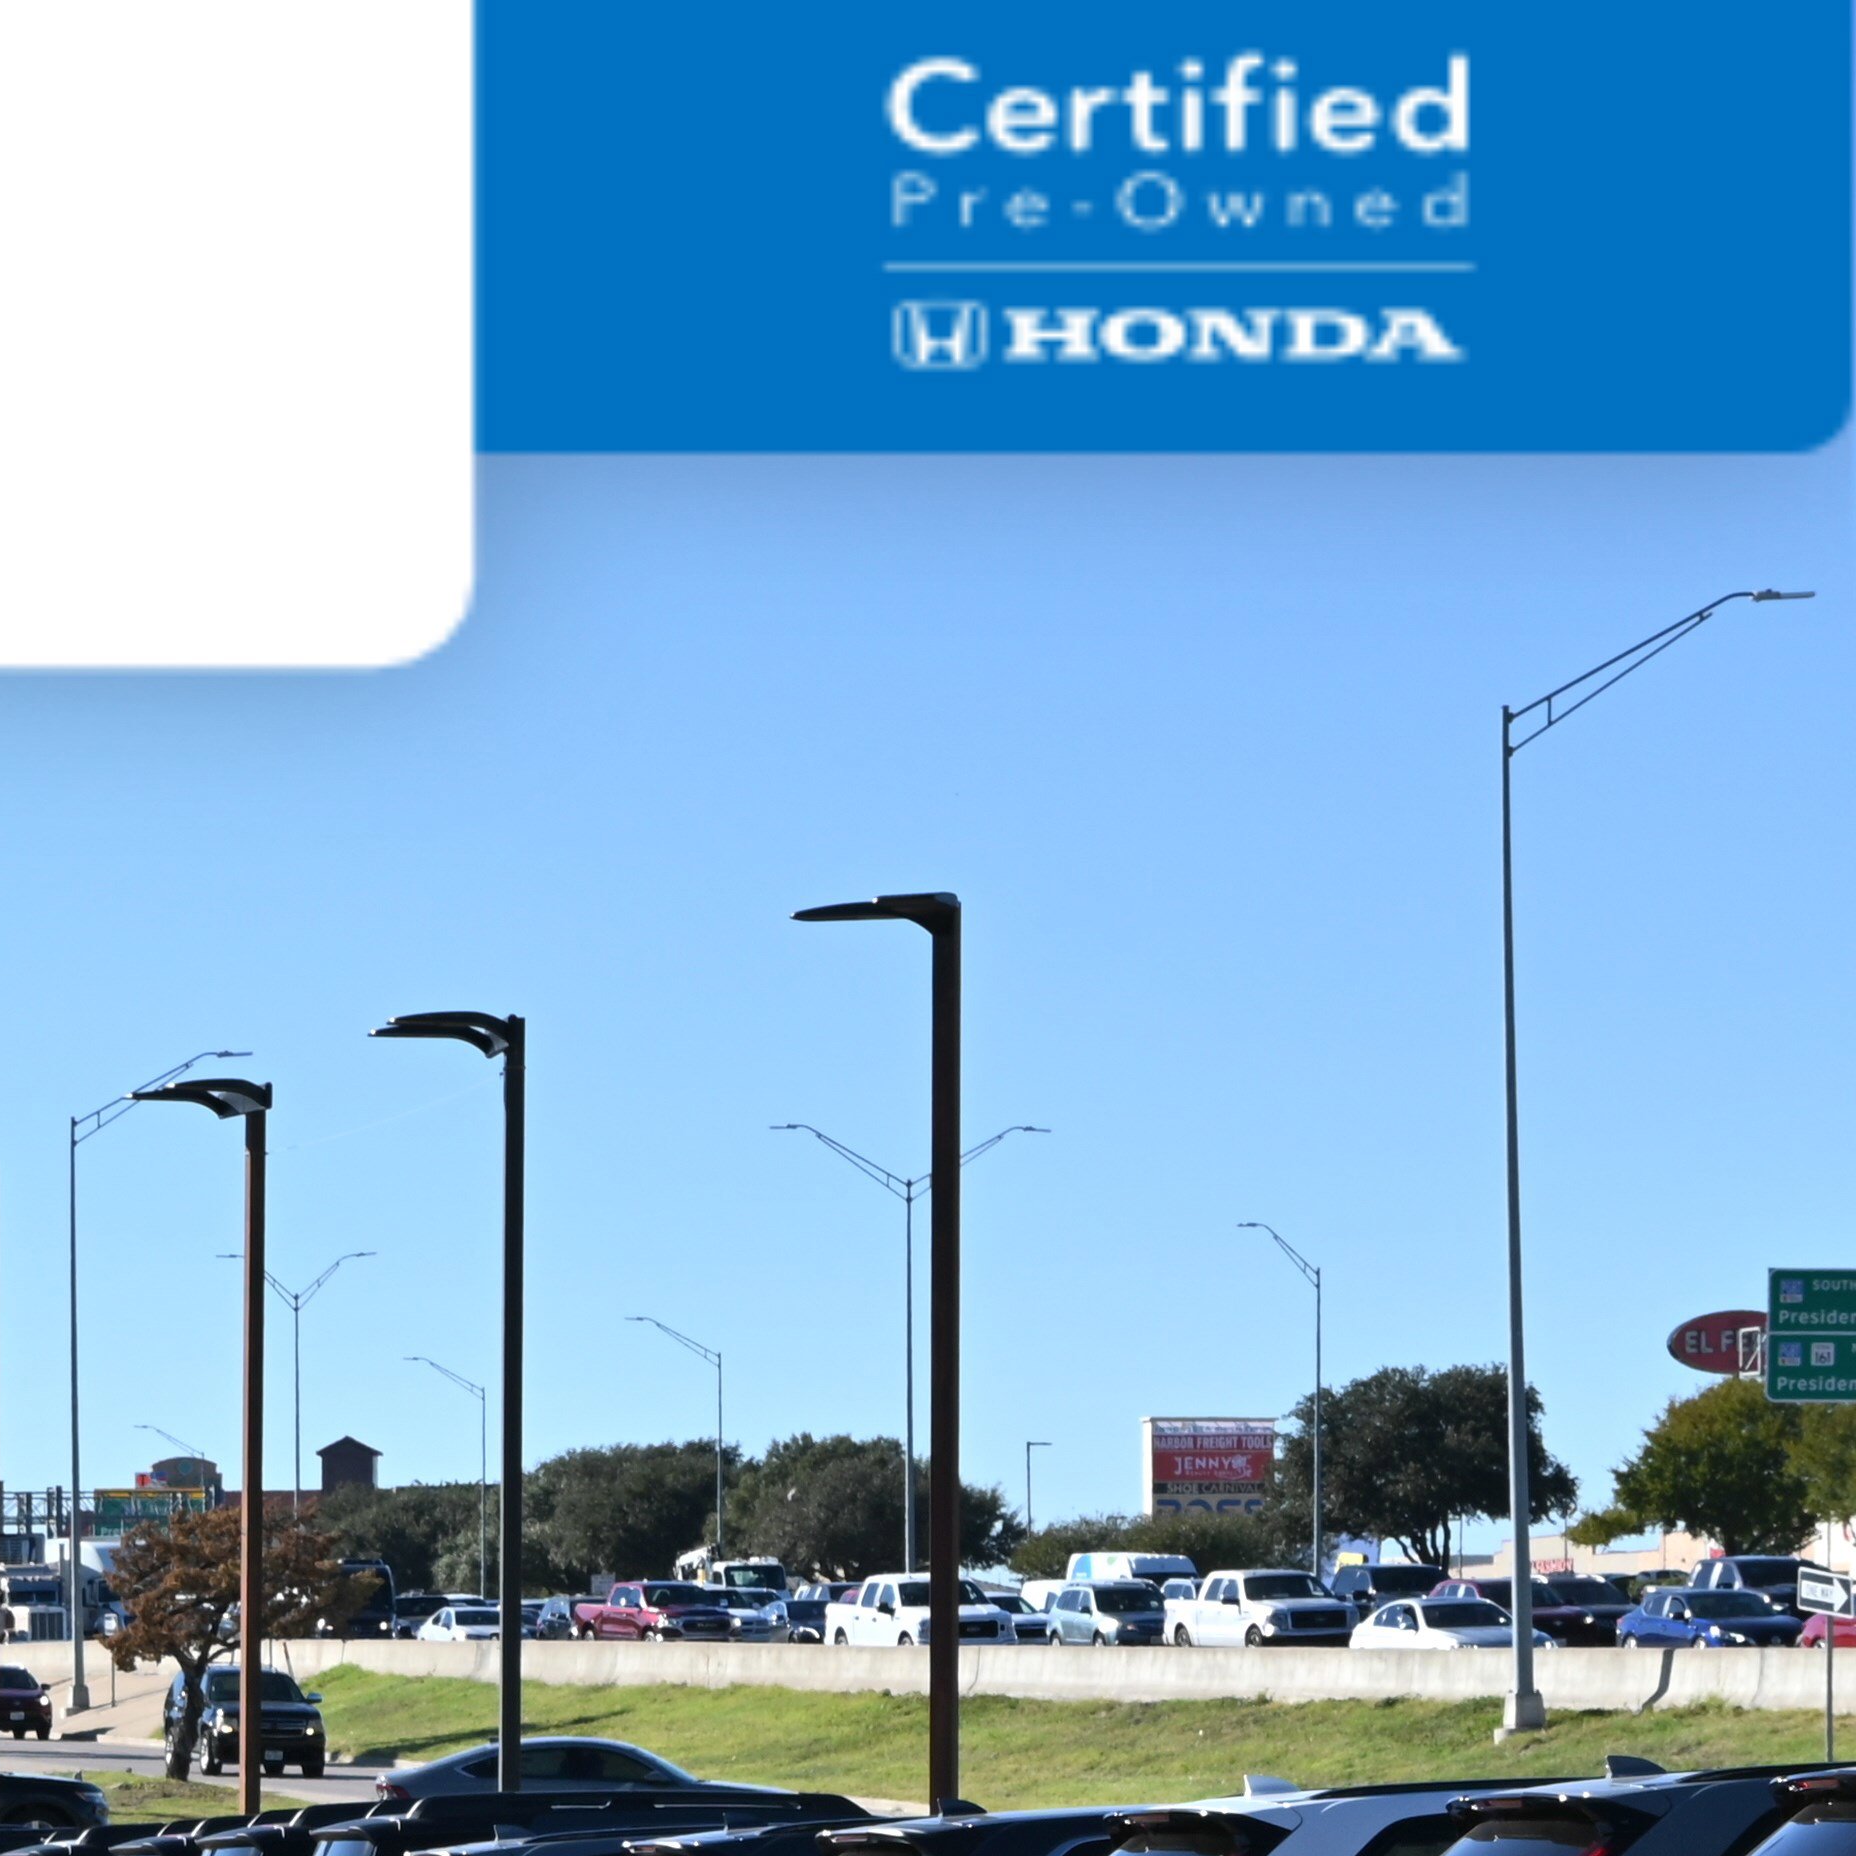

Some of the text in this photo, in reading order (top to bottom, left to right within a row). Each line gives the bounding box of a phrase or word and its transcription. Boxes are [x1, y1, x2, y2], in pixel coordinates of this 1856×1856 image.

[1685, 1330, 1714, 1353] EL
[1196, 1436, 1239, 1450] FREIGHT
[1241, 1435, 1273, 1450] TOOLS
[1174, 1456, 1232, 1475] JENNY
[1168, 1483, 1260, 1495] SHOE CARNIVAL
